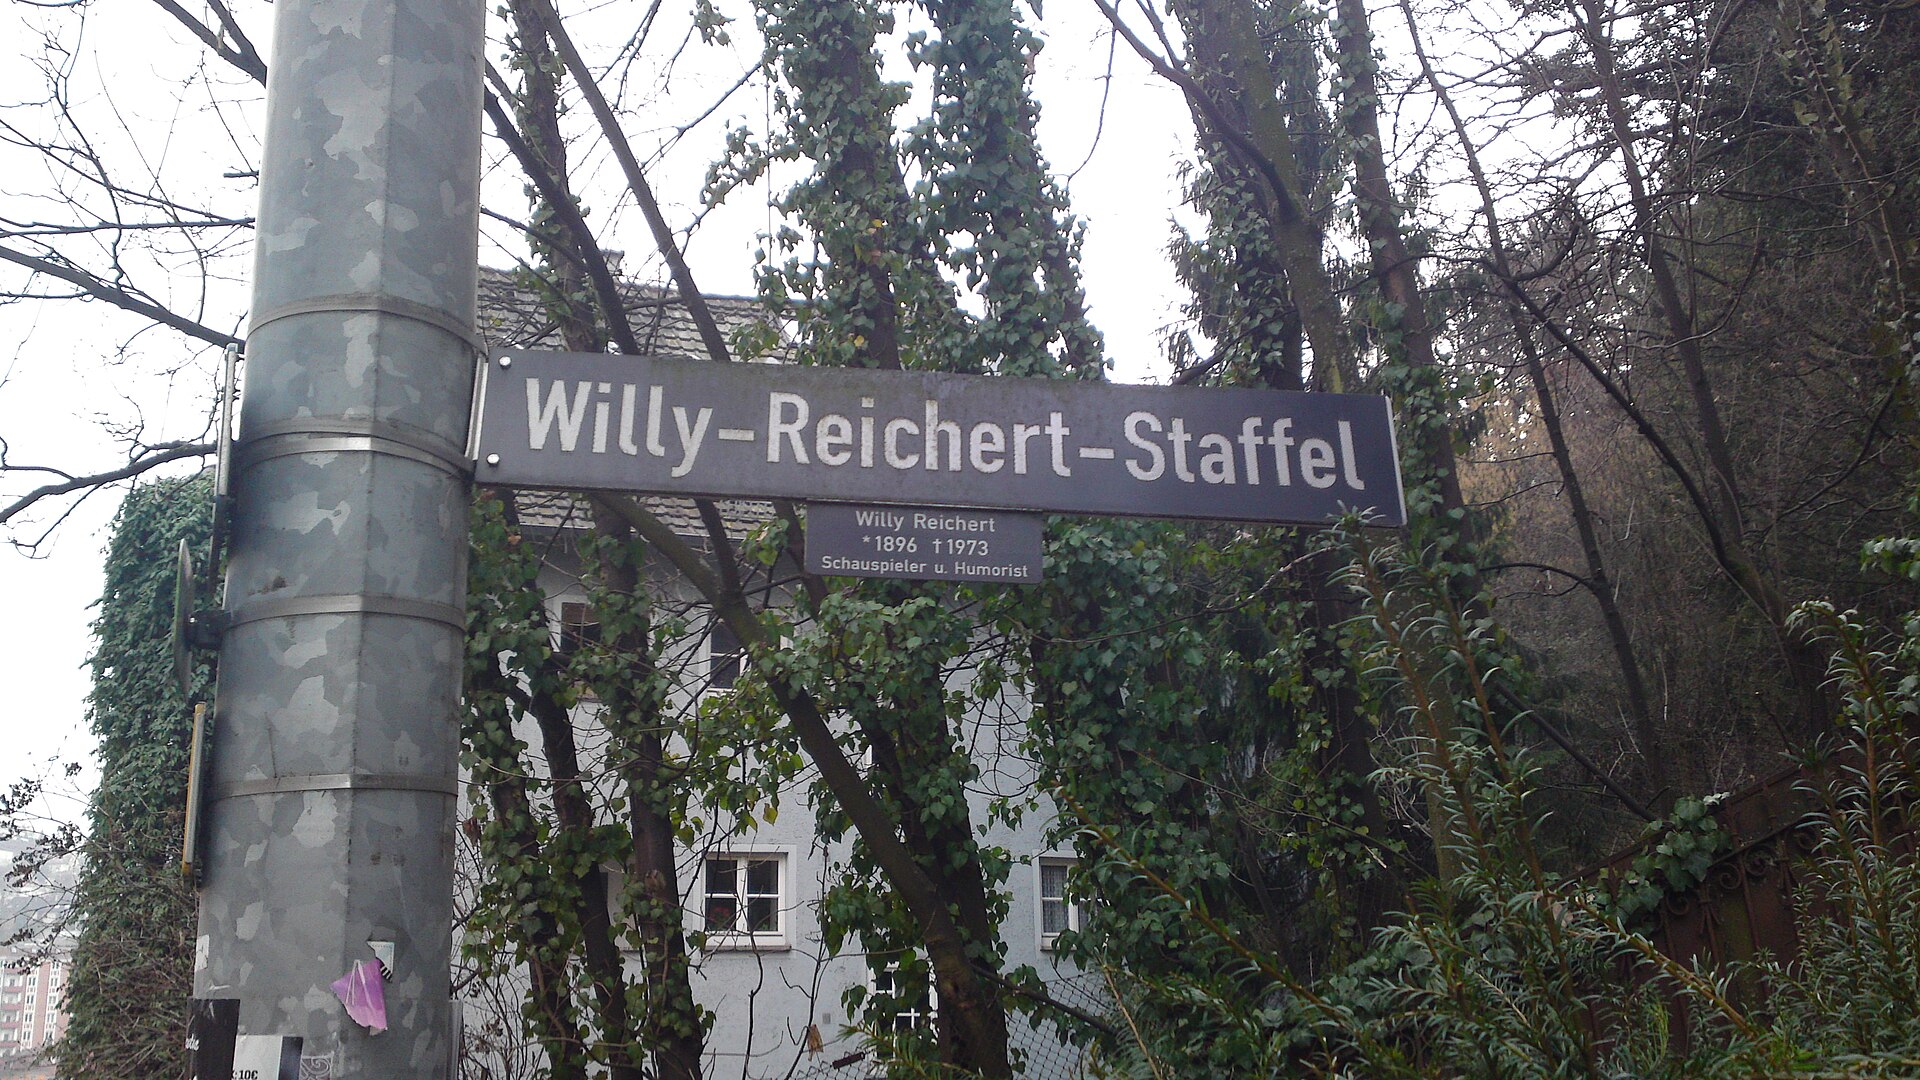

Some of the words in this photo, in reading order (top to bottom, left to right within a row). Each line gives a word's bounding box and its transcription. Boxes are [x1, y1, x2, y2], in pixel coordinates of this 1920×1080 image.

[525, 377, 1365, 490] Willy-Reichert-Staffel
[855, 511, 904, 531] Willy
[913, 514, 996, 532] Reichert
[821, 556, 927, 574] Schauspieler
[934, 563, 948, 574] u.
[954, 562, 1029, 578] Humorist
